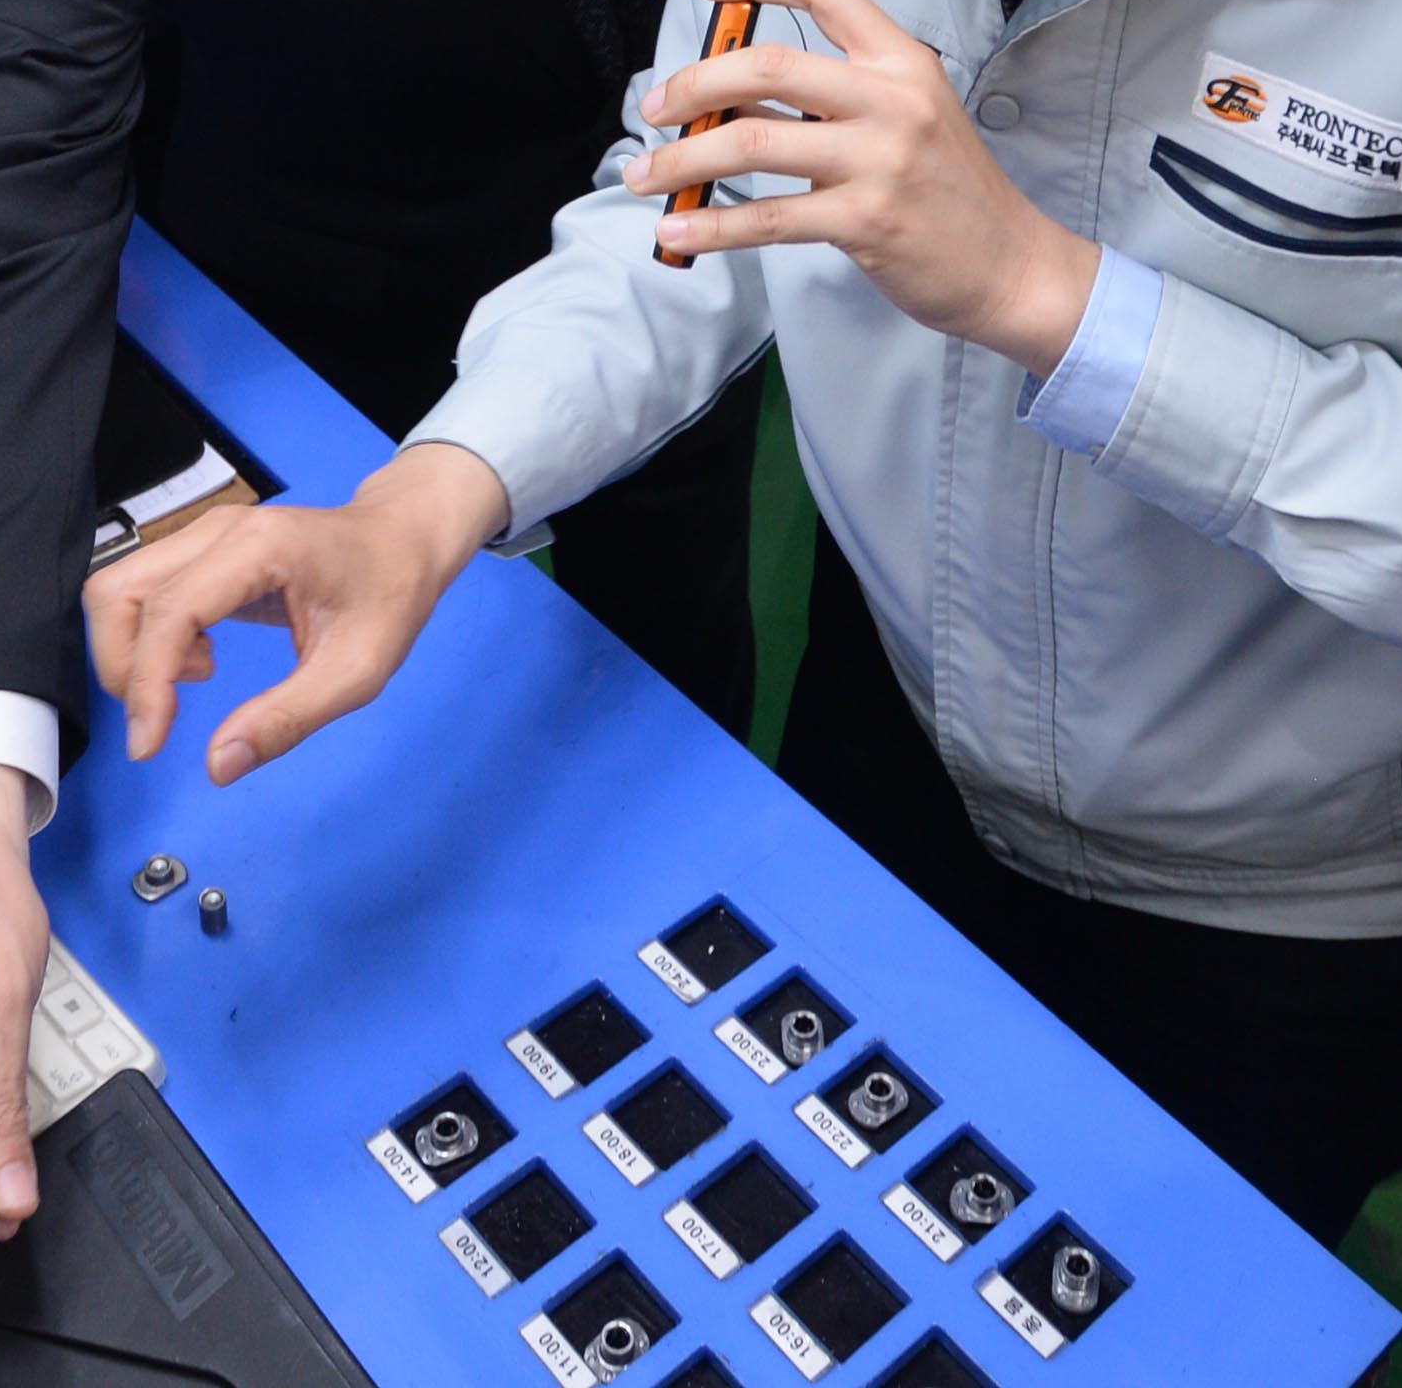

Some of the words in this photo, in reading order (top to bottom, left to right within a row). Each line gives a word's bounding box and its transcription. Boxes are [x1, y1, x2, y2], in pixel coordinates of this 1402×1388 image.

[1277, 122, 1325, 158] 주식회사
[653, 954, 690, 990] 24:00
[522, 1044, 559, 1082] 19:00
[731, 1031, 771, 1069] 23:00
[600, 1127, 638, 1169] 18:00
[813, 1110, 854, 1151] 22:00
[384, 1146, 421, 1186] 14:00
[681, 1216, 724, 1260] 17:00
[901, 1201, 946, 1244] 21:00
[455, 1234, 495, 1279] 12:00
[538, 1331, 579, 1378] 11:00
[769, 1312, 812, 1360] 16:00
